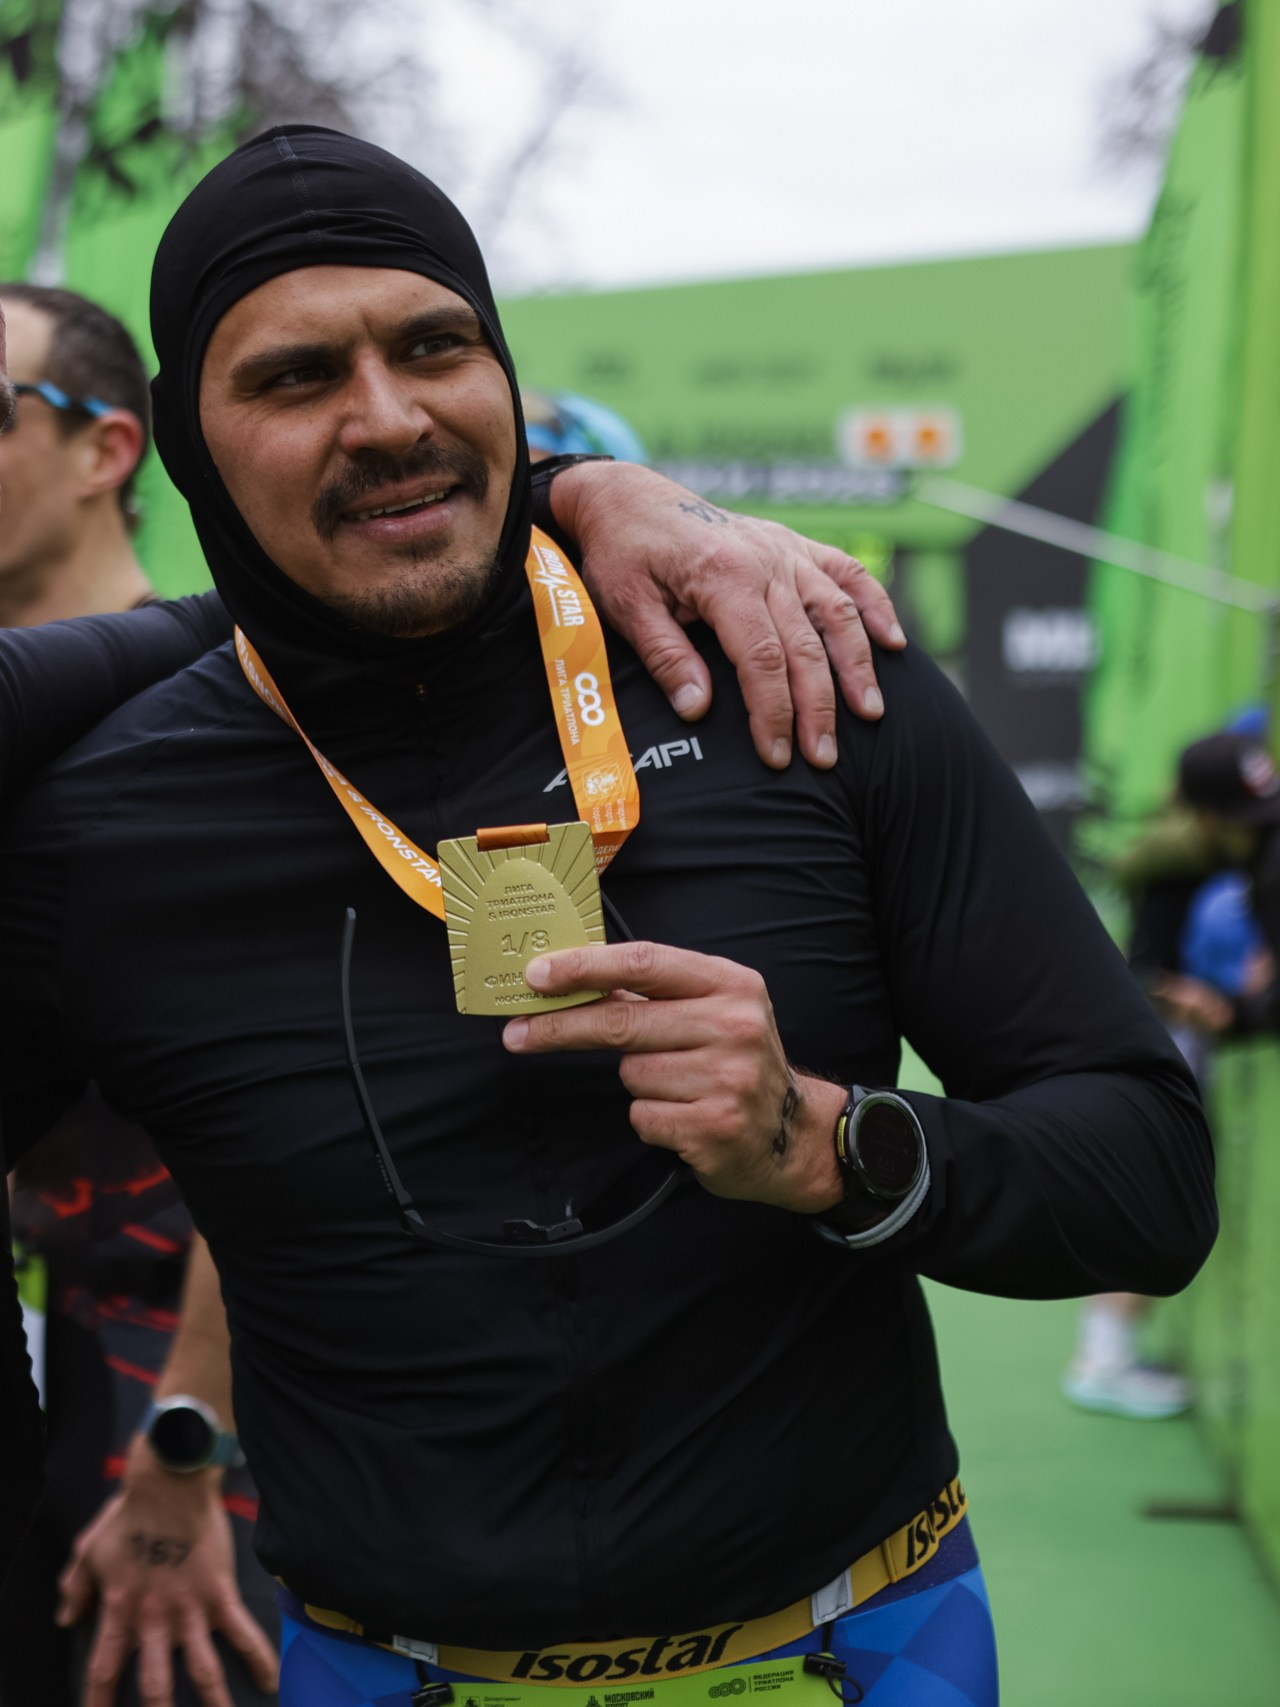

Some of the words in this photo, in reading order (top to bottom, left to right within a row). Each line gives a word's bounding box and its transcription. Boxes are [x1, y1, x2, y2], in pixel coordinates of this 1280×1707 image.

[540, 546, 568, 577] IRON
[557, 588, 585, 627] STAR
[555, 659, 565, 687] ЛИГА
[560, 687, 581, 746] ТРИАТЛОНА
[504, 883, 535, 897] ЛИГА
[485, 892, 556, 910] ТРИАТЛОНА
[498, 904, 557, 920] IRONSTAR
[501, 929, 551, 957] 1/8
[495, 992, 540, 1006] МОСКВА
[753, 1669, 795, 1681] ФЕДЕРАЦИЯ
[753, 1676, 795, 1686] ТРИАТЛОНА
[604, 1687, 655, 1703] МОСКОВСКИЙ
[754, 1684, 782, 1693] РОССИИ
